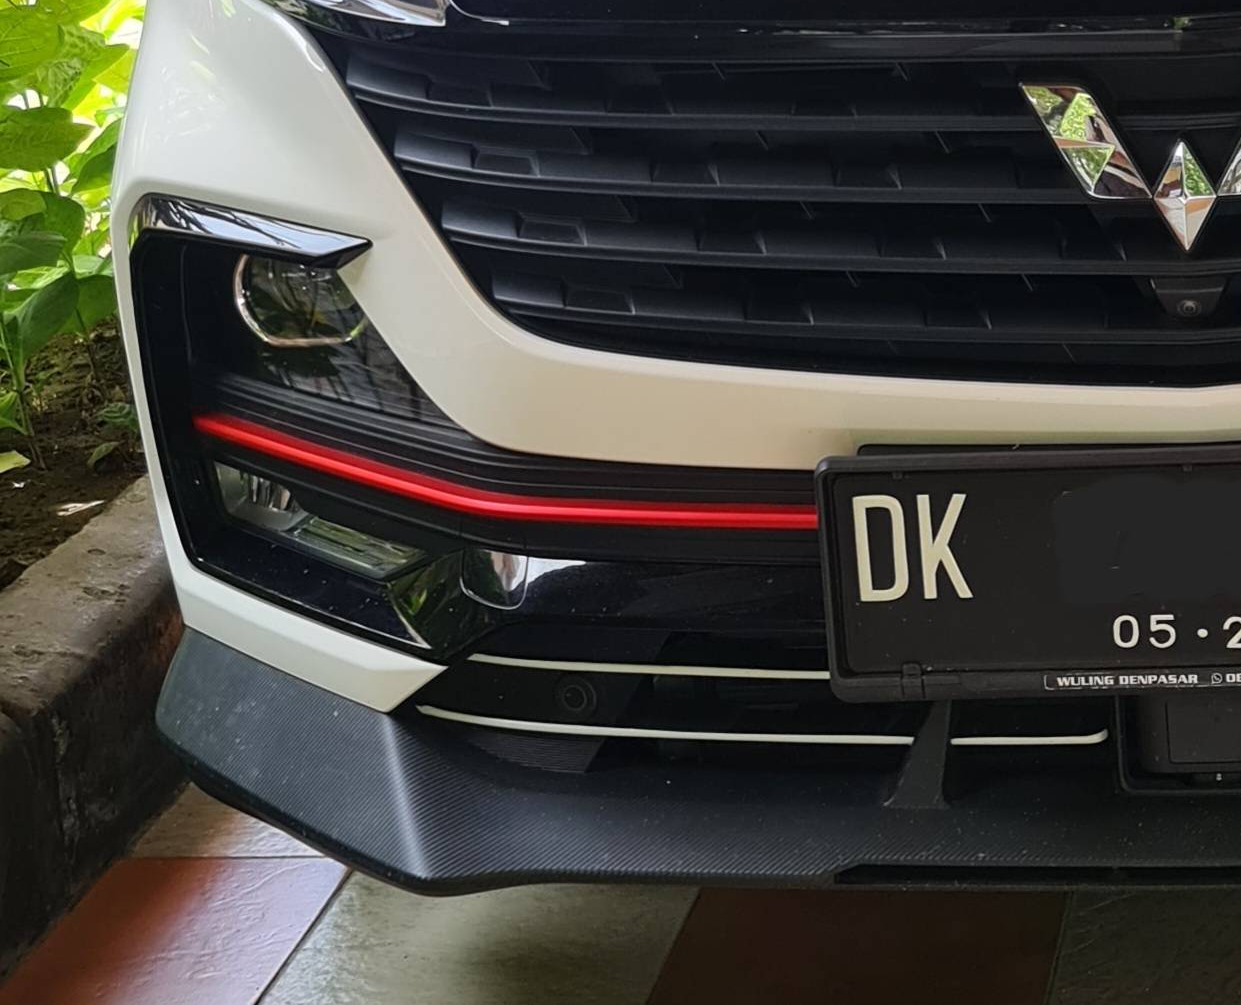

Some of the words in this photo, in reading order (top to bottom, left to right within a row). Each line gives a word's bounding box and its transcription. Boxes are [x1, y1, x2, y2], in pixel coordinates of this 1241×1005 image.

[852, 493, 973, 602] DK
[1056, 673, 1115, 686] WULING
[1118, 673, 1199, 685] DENPASAR
